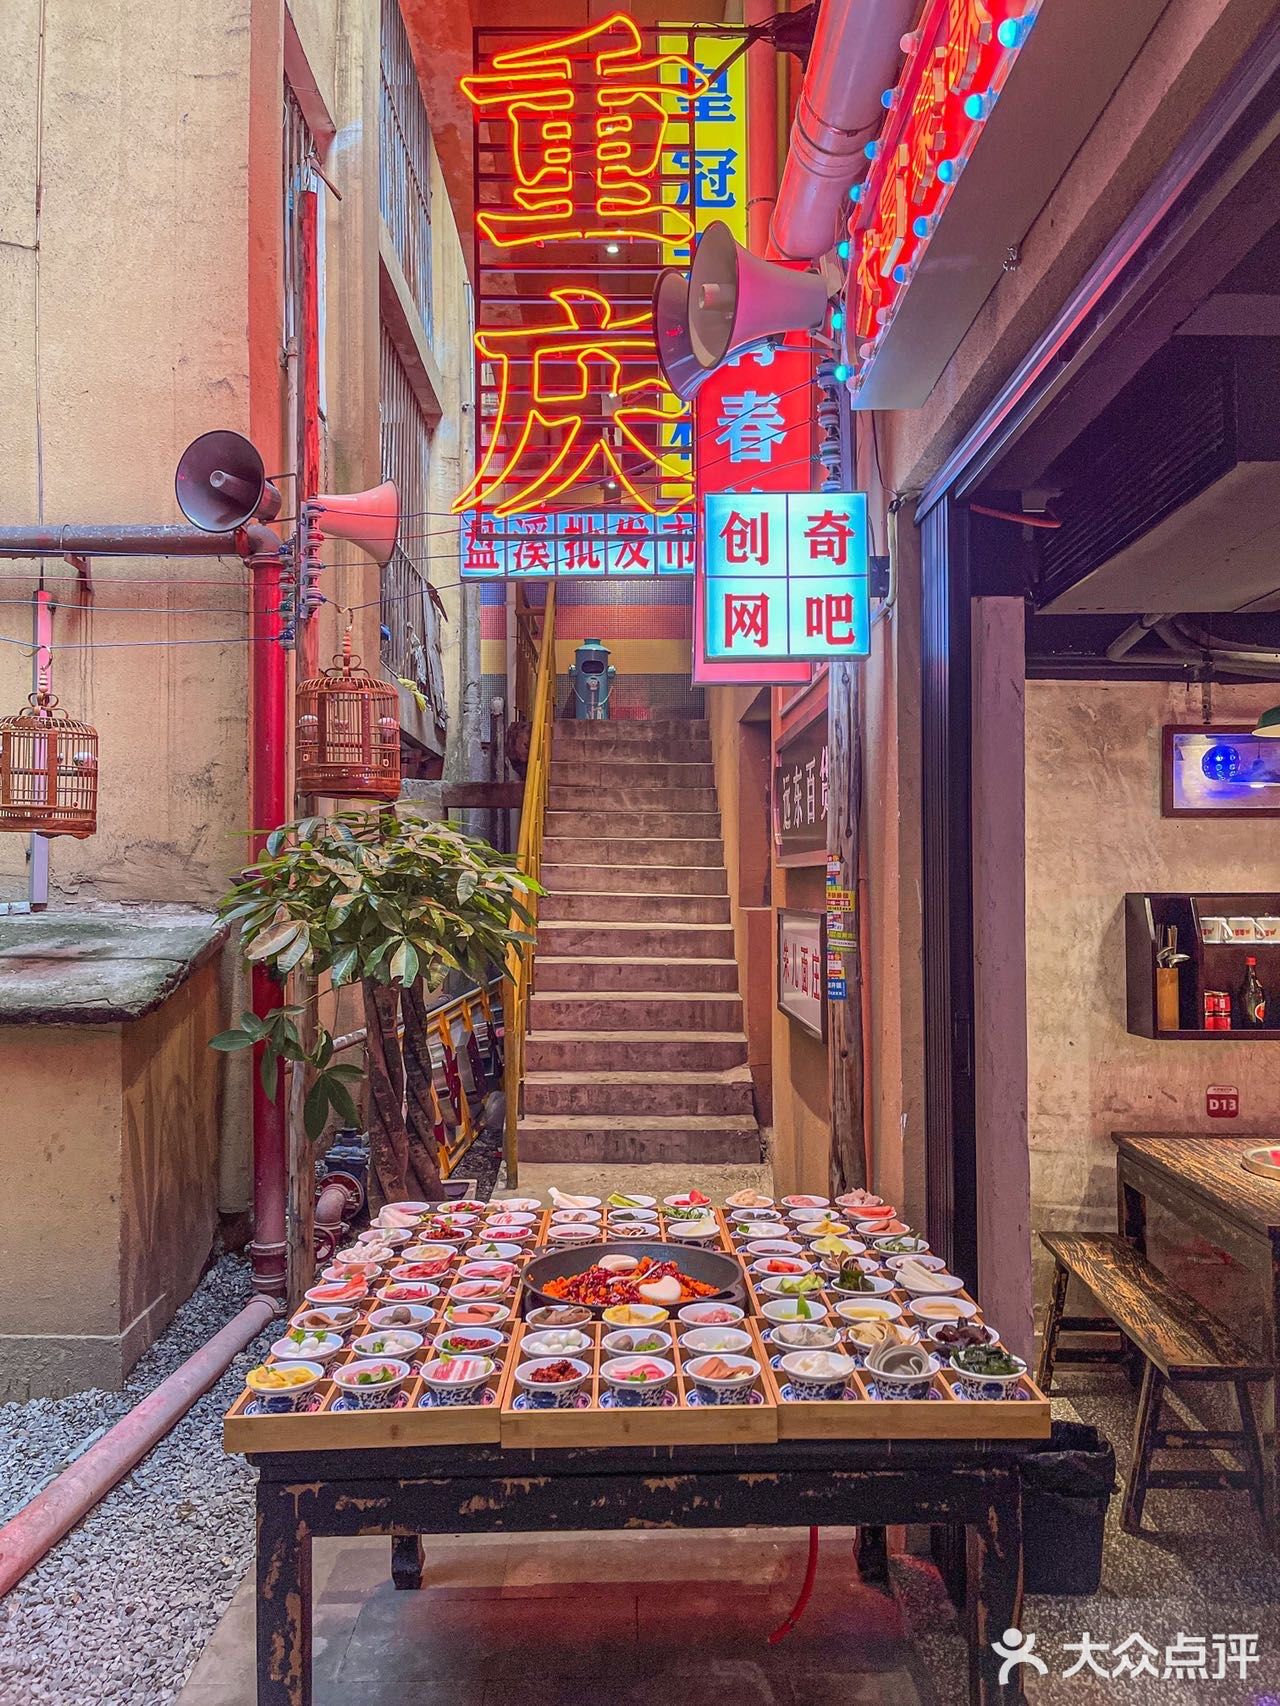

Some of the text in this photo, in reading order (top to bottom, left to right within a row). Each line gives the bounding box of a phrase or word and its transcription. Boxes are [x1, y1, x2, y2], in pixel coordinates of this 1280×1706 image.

[450, 15, 710, 518] 重庆
[464, 515, 695, 571] 盘溪批发市
[719, 510, 855, 566] 创奇
[724, 592, 855, 648] 网吧
[1209, 1099, 1237, 1110] D13
